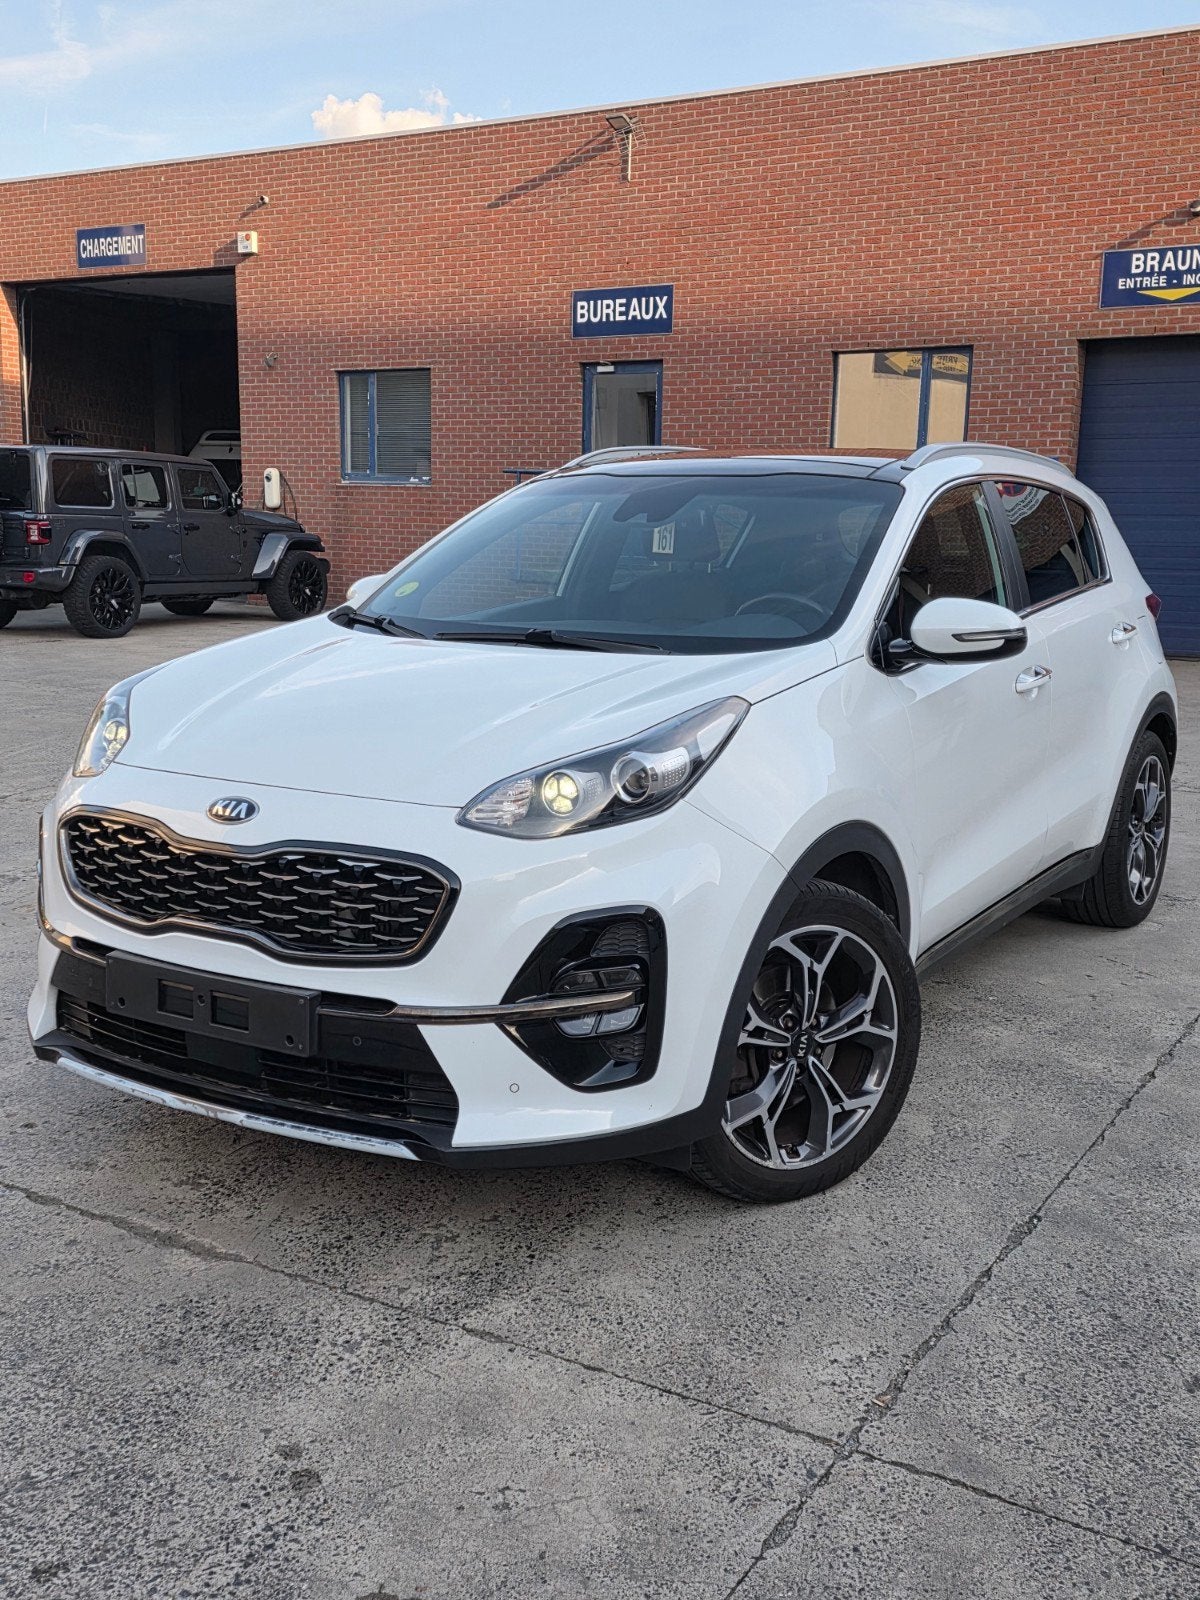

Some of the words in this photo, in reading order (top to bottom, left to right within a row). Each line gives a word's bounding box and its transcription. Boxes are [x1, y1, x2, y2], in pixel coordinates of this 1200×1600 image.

[80, 234, 144, 258] CHARGEMENT
[1118, 273, 1168, 289] ENTRÉE
[576, 295, 668, 323] BUREAUX
[212, 800, 248, 818] KIA
[797, 1034, 808, 1057] KIA
